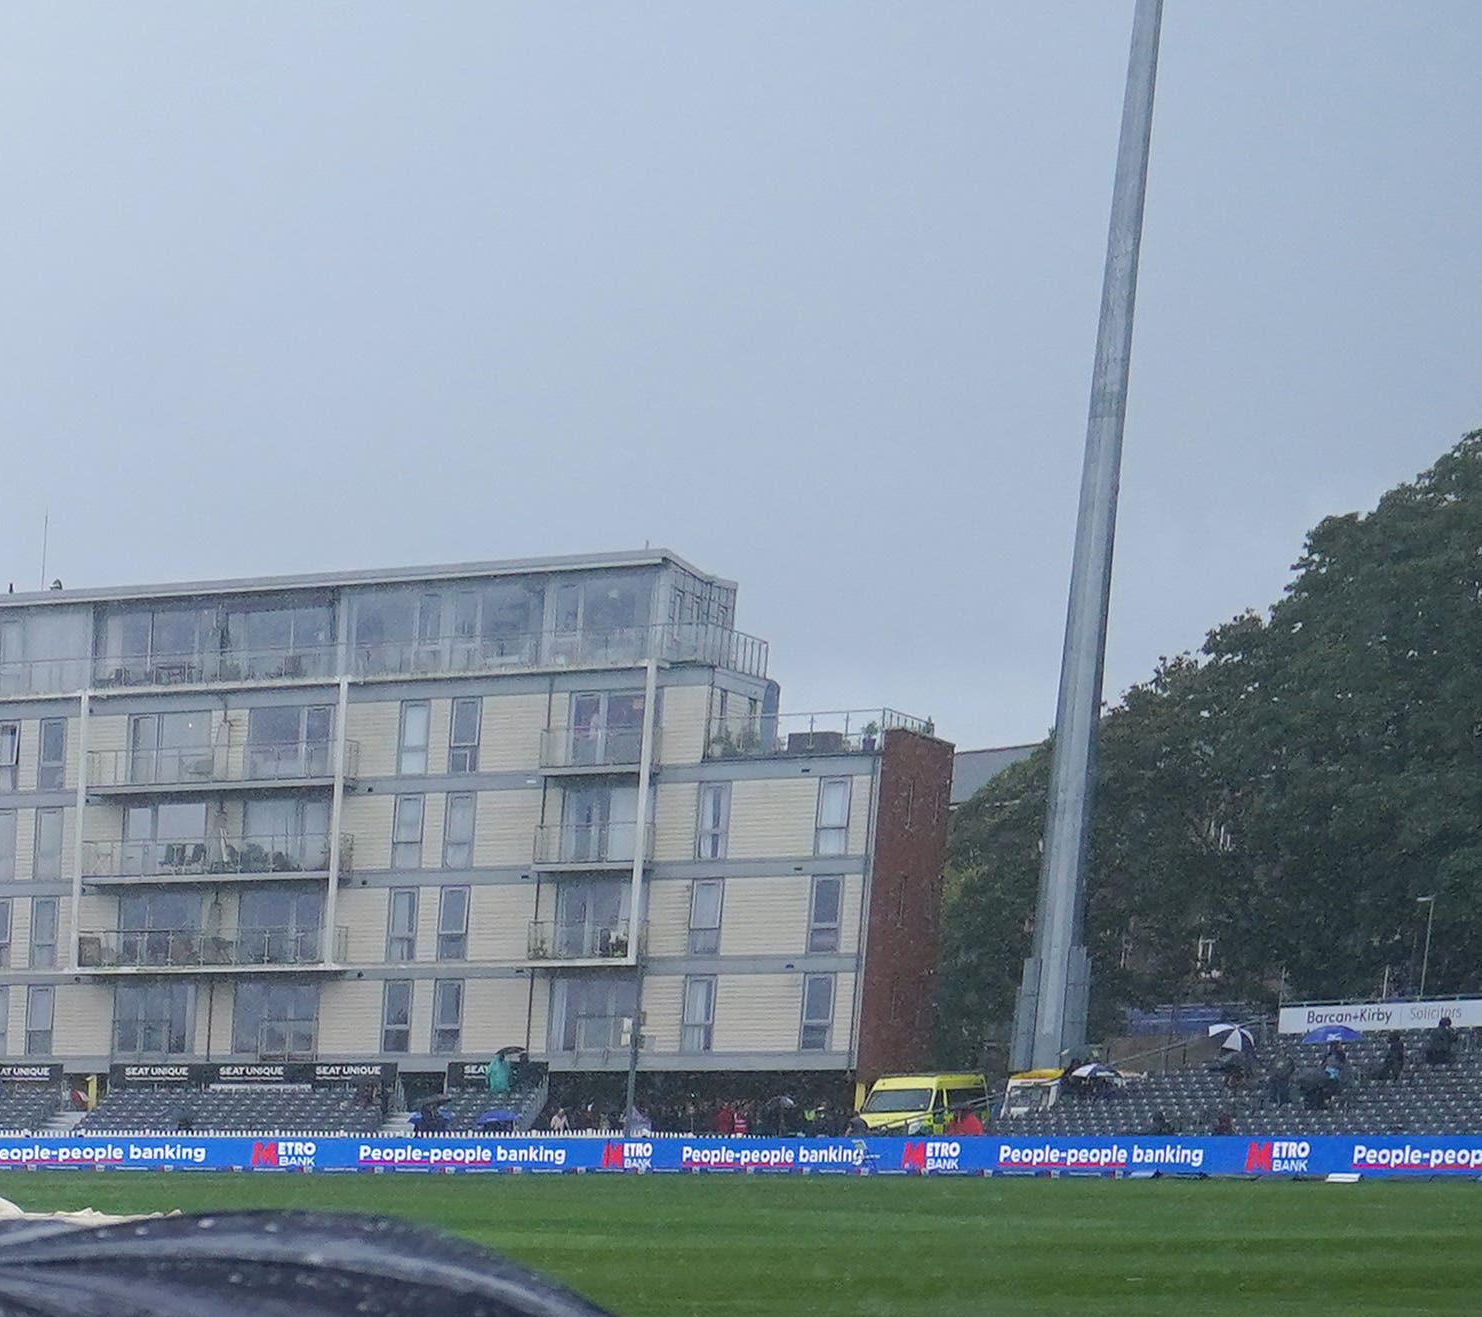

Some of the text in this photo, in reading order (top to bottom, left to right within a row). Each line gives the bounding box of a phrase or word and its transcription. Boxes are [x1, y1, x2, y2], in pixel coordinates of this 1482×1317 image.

[1307, 1009, 1392, 1025] Barcan+Kirby
[15, 1068, 50, 1077] UNIQUE
[125, 1067, 188, 1077] SEAT UNIQUE
[219, 1067, 284, 1076] SEAT UNIQUE
[316, 1066, 381, 1075] SEAT UNIQUE
[129, 1145, 205, 1162] banking
[252, 1142, 316, 1166] METRO
[278, 1156, 315, 1166] BANK
[359, 1144, 566, 1163] People-people banking
[602, 1142, 652, 1168] METRO
[683, 1145, 863, 1166] People-people banking
[902, 1142, 960, 1170] METRO
[998, 1145, 1204, 1166] People-people banking
[1245, 1141, 1310, 1171] METRO
[624, 1158, 652, 1168] BANK
[927, 1156, 958, 1170] BANK
[1272, 1158, 1308, 1171] BANK
